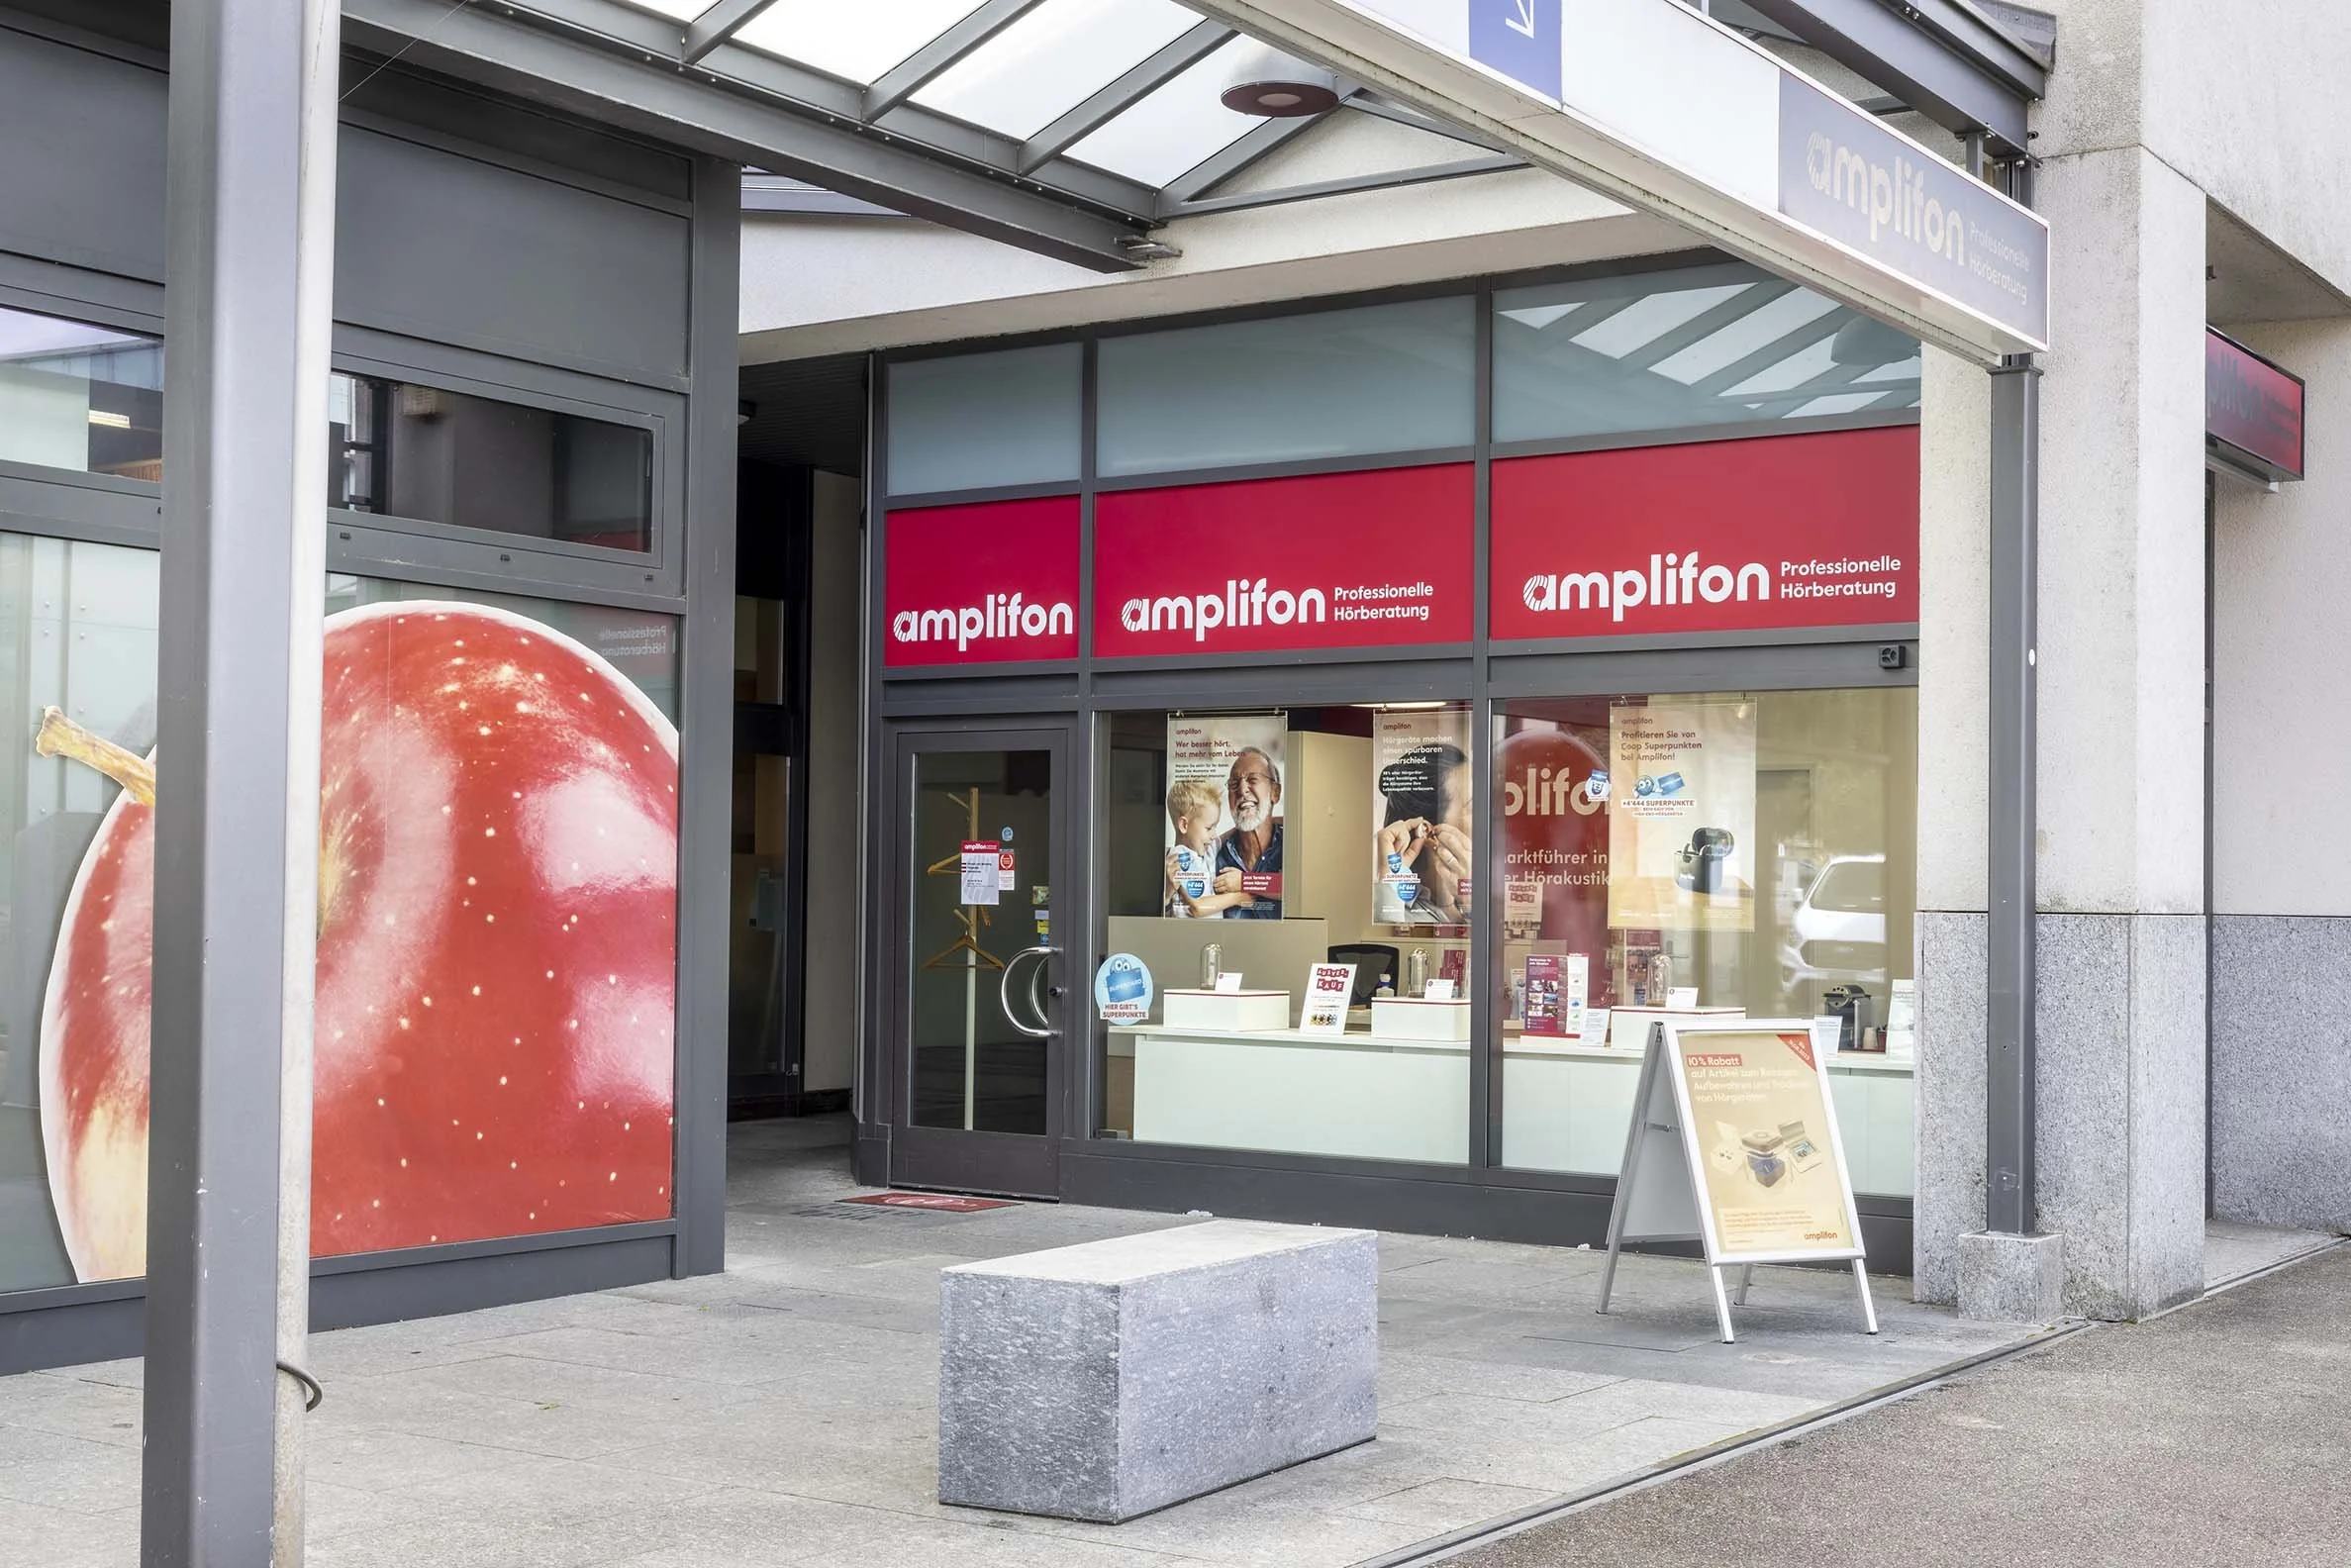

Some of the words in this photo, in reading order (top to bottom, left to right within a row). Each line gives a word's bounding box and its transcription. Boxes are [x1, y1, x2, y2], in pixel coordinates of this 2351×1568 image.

[1807, 131, 1965, 265] amplifon
[1969, 220, 2030, 272] Professionelle
[1781, 556, 1901, 577] Professionelle
[1334, 582, 1433, 601] Professionelle
[1518, 551, 1769, 622] amplifon
[1781, 579, 1896, 599] Hörberatung
[1122, 577, 1325, 641] amplifon
[1334, 605, 1429, 622] Hörberatung
[893, 592, 1073, 652] amplifon
[1383, 722, 1412, 731] amplifon
[1621, 717, 1653, 727] amplifon
[1422, 734, 1453, 742] machen
[1621, 731, 1664, 739] Profitieren
[1666, 730, 1679, 738] Sie
[1621, 742, 1642, 751] Coop
[1644, 741, 1703, 751] Superpunkten
[1636, 752, 1675, 762] Amplifon!
[1505, 767, 1610, 816] lifo
[1593, 849, 1608, 864] in
[1318, 979, 1344, 991] KAUF
[1708, 1056, 1740, 1066] Rabatt
[1804, 1230, 1838, 1242] amplifon
